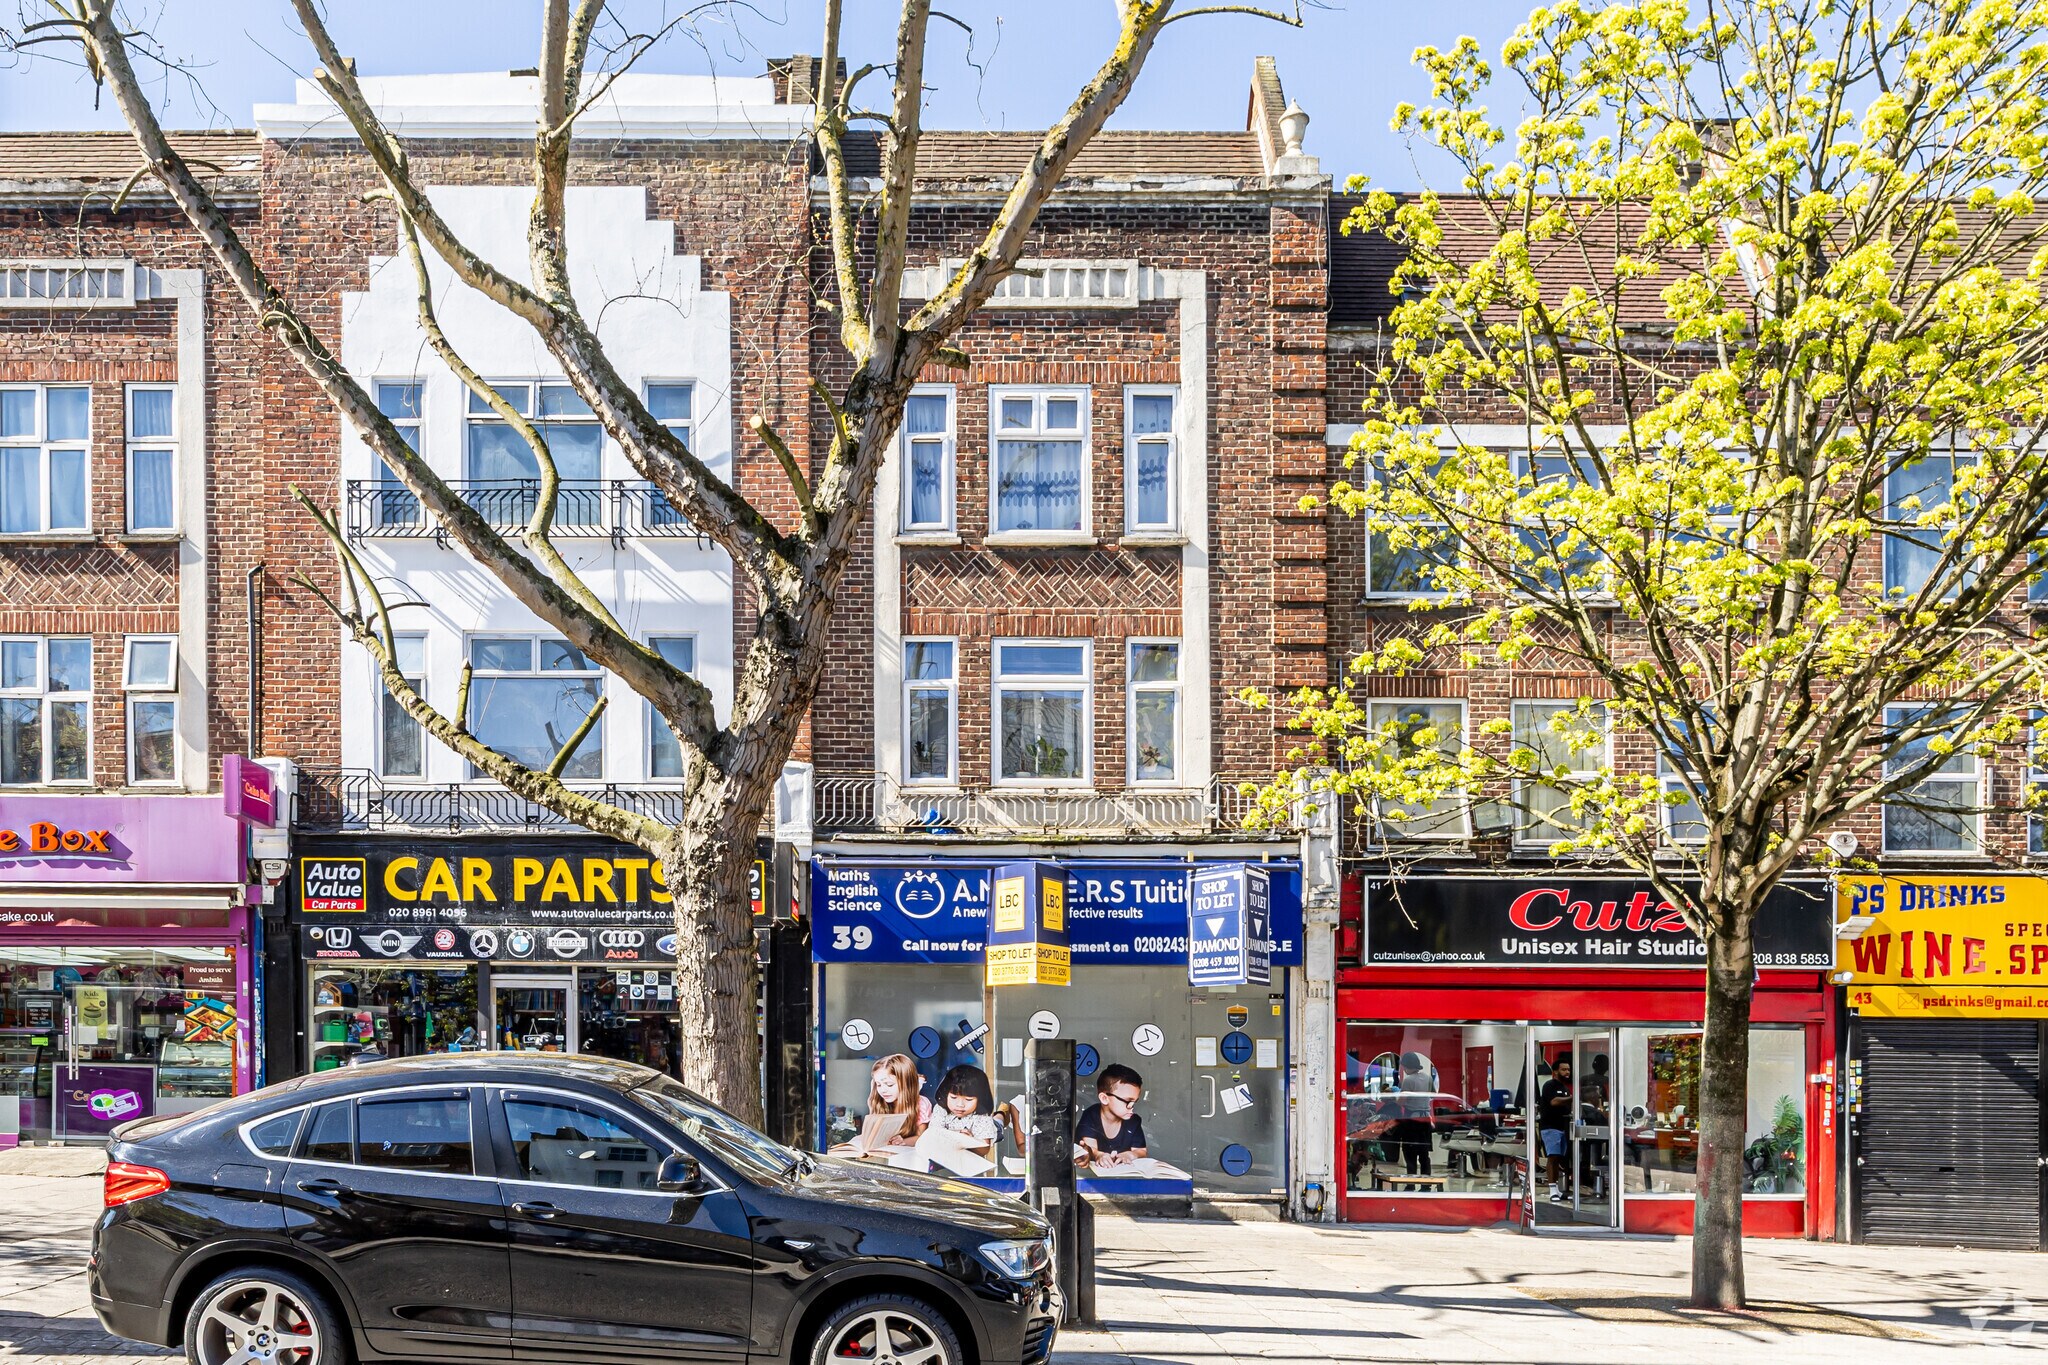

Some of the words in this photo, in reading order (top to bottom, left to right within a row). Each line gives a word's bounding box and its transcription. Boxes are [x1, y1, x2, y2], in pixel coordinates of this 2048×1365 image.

[29, 821, 111, 852] Box
[307, 863, 361, 880] Auto
[828, 870, 870, 881] Maths
[384, 856, 497, 902] CAR
[306, 881, 362, 897] Value
[828, 885, 878, 898] English
[1201, 880, 1228, 894] SHOP
[1252, 880, 1264, 893] SHOP
[1370, 882, 1381, 890] 41
[311, 900, 328, 909] Car
[330, 900, 357, 909] Parts
[828, 900, 881, 911] Science
[1000, 894, 1019, 908] LBC
[1046, 893, 1059, 909] LBC
[1196, 897, 1212, 911] TO
[1213, 893, 1235, 909] LET
[1249, 893, 1257, 906] TO
[1257, 894, 1267, 909] LET
[1851, 884, 1884, 915] PS
[1900, 885, 2005, 911] DRINKS
[388, 908, 409, 917] 020
[412, 908, 436, 917] 8961
[440, 908, 467, 917] 4096
[1107, 907, 1143, 918] results
[1509, 888, 1692, 932] Cutz
[2005, 923, 2048, 936] SPE
[382, 939, 400, 947] MINI
[832, 925, 872, 950] 39
[902, 940, 929, 951] Call
[931, 941, 960, 951] now
[961, 940, 982, 951] for
[1070, 942, 1110, 952] sment
[1113, 943, 1129, 952] on
[1193, 937, 1240, 954] DIAMOND
[1501, 938, 1578, 955] Unisex
[1585, 938, 1631, 955] Hair
[1638, 938, 1707, 956] Studio
[605, 949, 638, 958] Audi
[989, 950, 1007, 961] SHOP
[1008, 949, 1017, 959] TO
[1019, 948, 1031, 958] LET
[1038, 948, 1052, 958] SHOP
[1053, 950, 1059, 960] TO
[1060, 951, 1068, 961] LET
[1373, 951, 1485, 962] cutzunisex@yahoo.co.uk
[1775, 953, 1797, 964] 838
[1800, 953, 1829, 964] 5853
[1224, 956, 1239, 966] 1000
[1854, 992, 1872, 1004] 43
